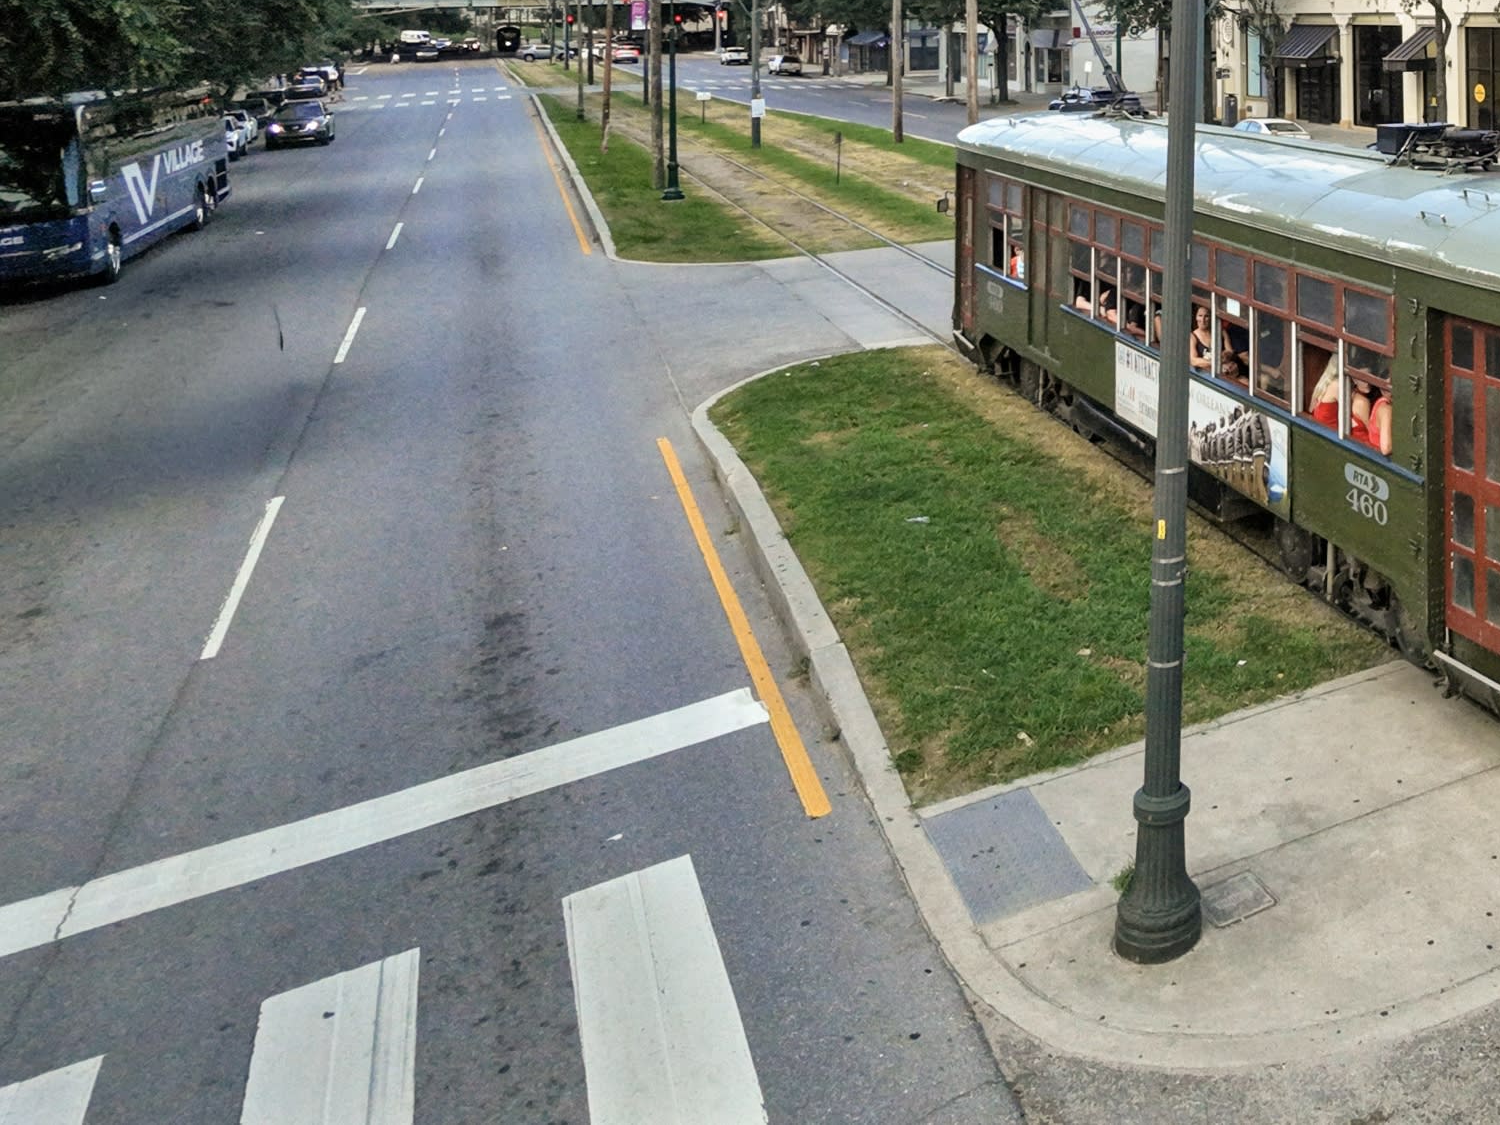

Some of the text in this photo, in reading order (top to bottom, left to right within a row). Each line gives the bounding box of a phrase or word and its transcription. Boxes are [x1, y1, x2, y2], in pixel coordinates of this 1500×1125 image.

[162, 139, 204, 174] VILLAGE
[1353, 470, 1369, 488] RTA
[1345, 488, 1388, 525] 460
